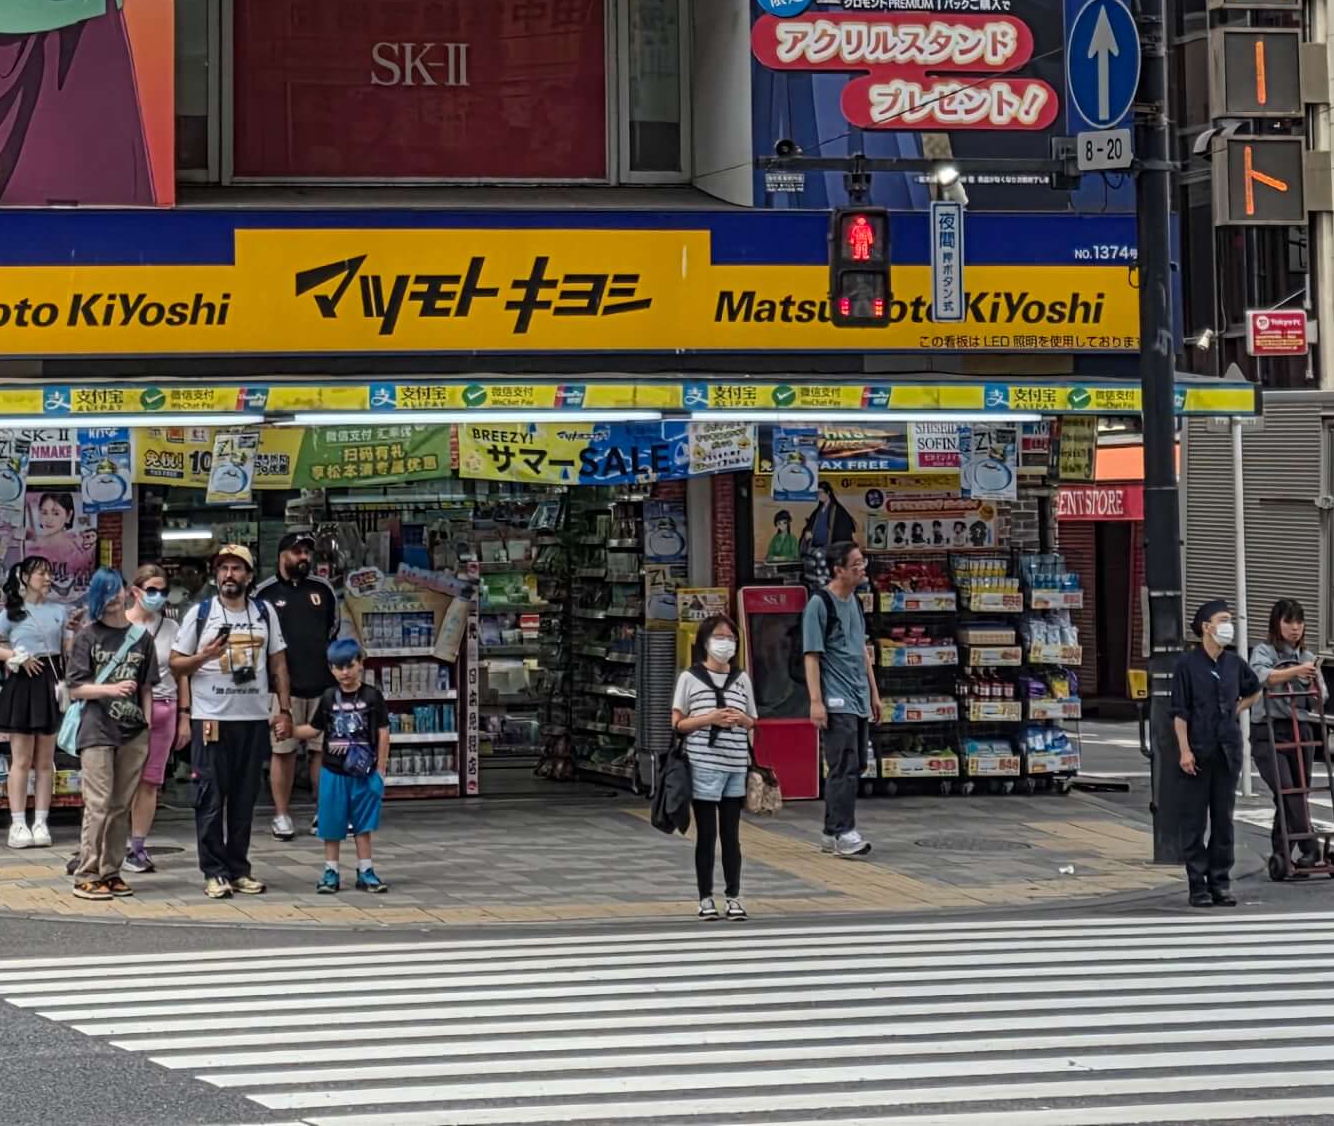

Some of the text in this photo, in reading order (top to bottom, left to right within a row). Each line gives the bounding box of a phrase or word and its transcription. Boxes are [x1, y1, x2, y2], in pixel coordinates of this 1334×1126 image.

[776, 20, 1018, 65] アクリルスタンド
[1085, 141, 1122, 161] 8-20
[939, 212, 956, 249] 夜間
[295, 253, 653, 336] マツモトキヨシ
[67, 292, 230, 327] KiYoshi
[964, 292, 1105, 325] KiYoshi
[919, 336, 979, 348] この看板は
[984, 336, 1009, 347] LED
[77, 389, 123, 404] 支付宝
[400, 386, 446, 401] 支付宝
[714, 386, 757, 400] 支付宝
[1014, 388, 1056, 403] 支付宝
[472, 427, 534, 445] BREEZY!
[917, 437, 957, 451] SOFIN
[847, 460, 890, 470] FREE
[1085, 489, 1125, 514] STORE
